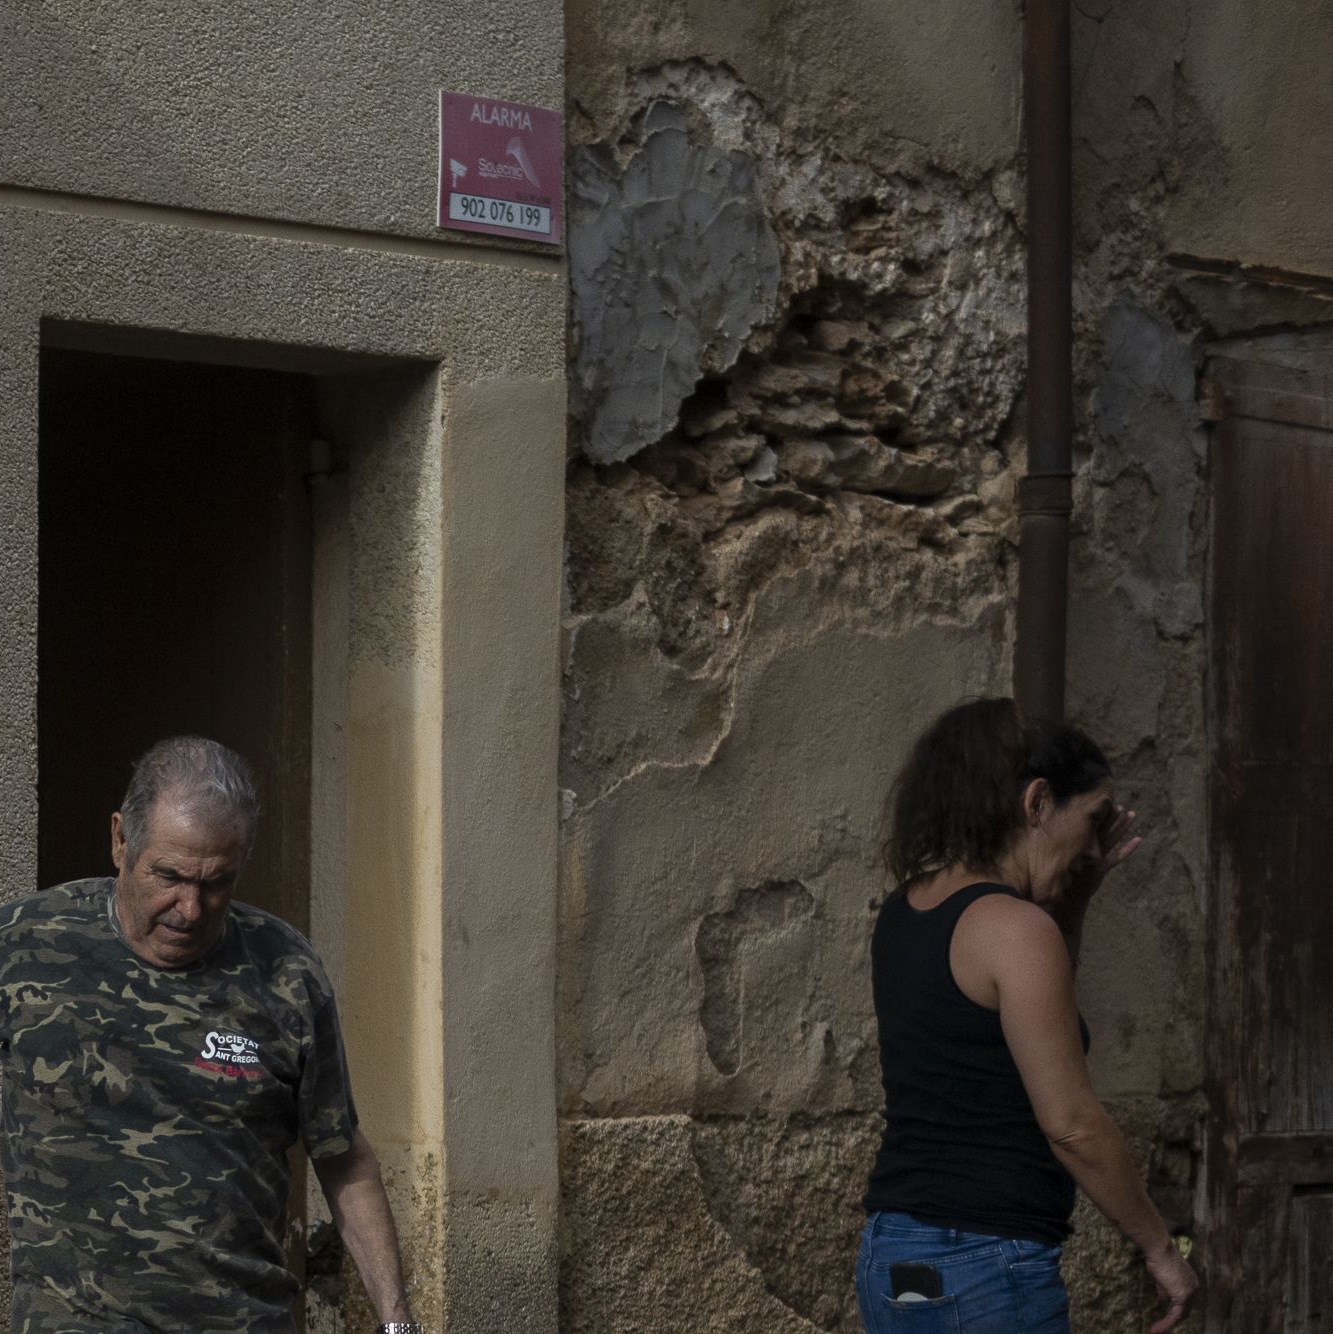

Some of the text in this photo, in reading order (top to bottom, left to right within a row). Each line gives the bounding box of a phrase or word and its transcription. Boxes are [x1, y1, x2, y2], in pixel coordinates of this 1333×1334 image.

[471, 103, 533, 131] ALARMA
[461, 197, 542, 227] 902 076 199
[201, 1031, 259, 1059] SOCIETAT
